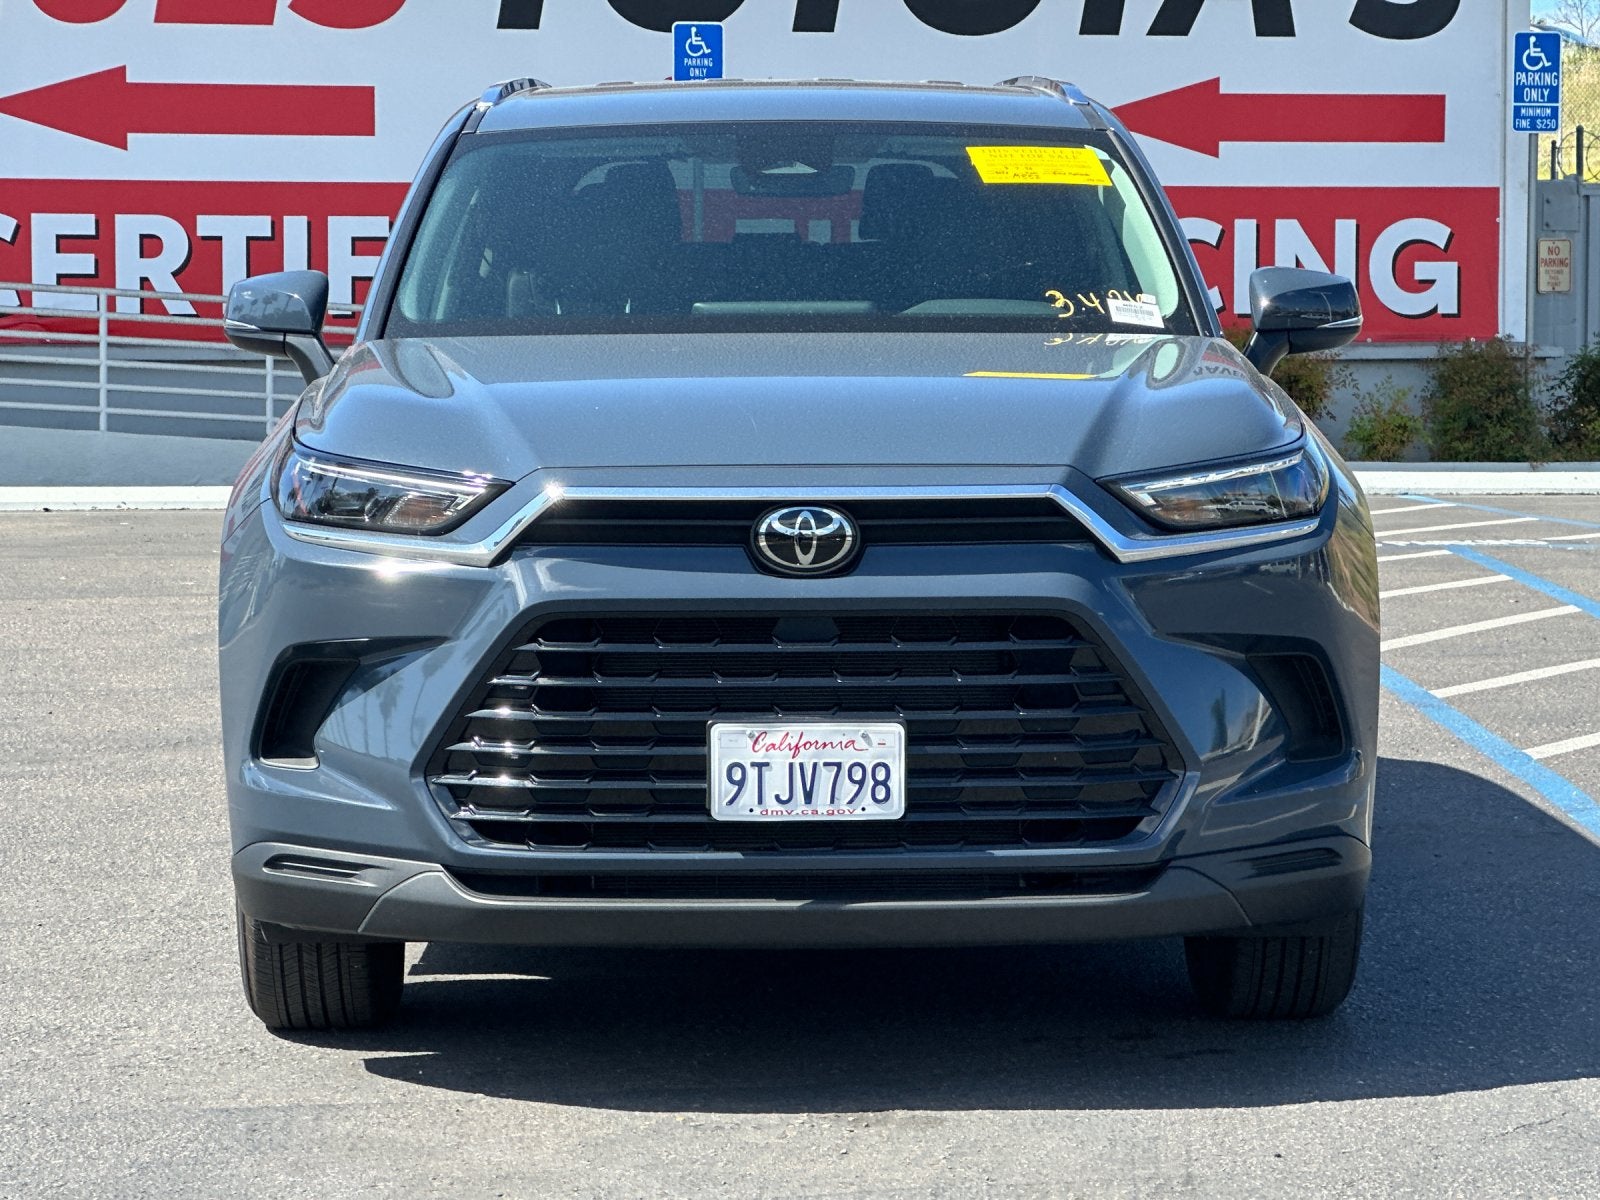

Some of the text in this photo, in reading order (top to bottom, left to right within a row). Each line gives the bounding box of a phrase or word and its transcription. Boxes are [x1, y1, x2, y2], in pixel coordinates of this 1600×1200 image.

[684, 58, 713, 67] PARKING
[690, 68, 707, 77] ONLY
[1515, 72, 1558, 86] PARKING
[1523, 88, 1550, 102] ONLY
[1520, 107, 1552, 117] MINIMUM
[1515, 118, 1556, 129] FINE $250
[1547, 245, 1560, 256] NO
[0, 213, 391, 316] ERTIF
[1540, 257, 1568, 268] PARKING
[752, 731, 869, 759] California
[725, 762, 892, 806] 9TJV798
[759, 808, 857, 817] dmv.ca.gov
